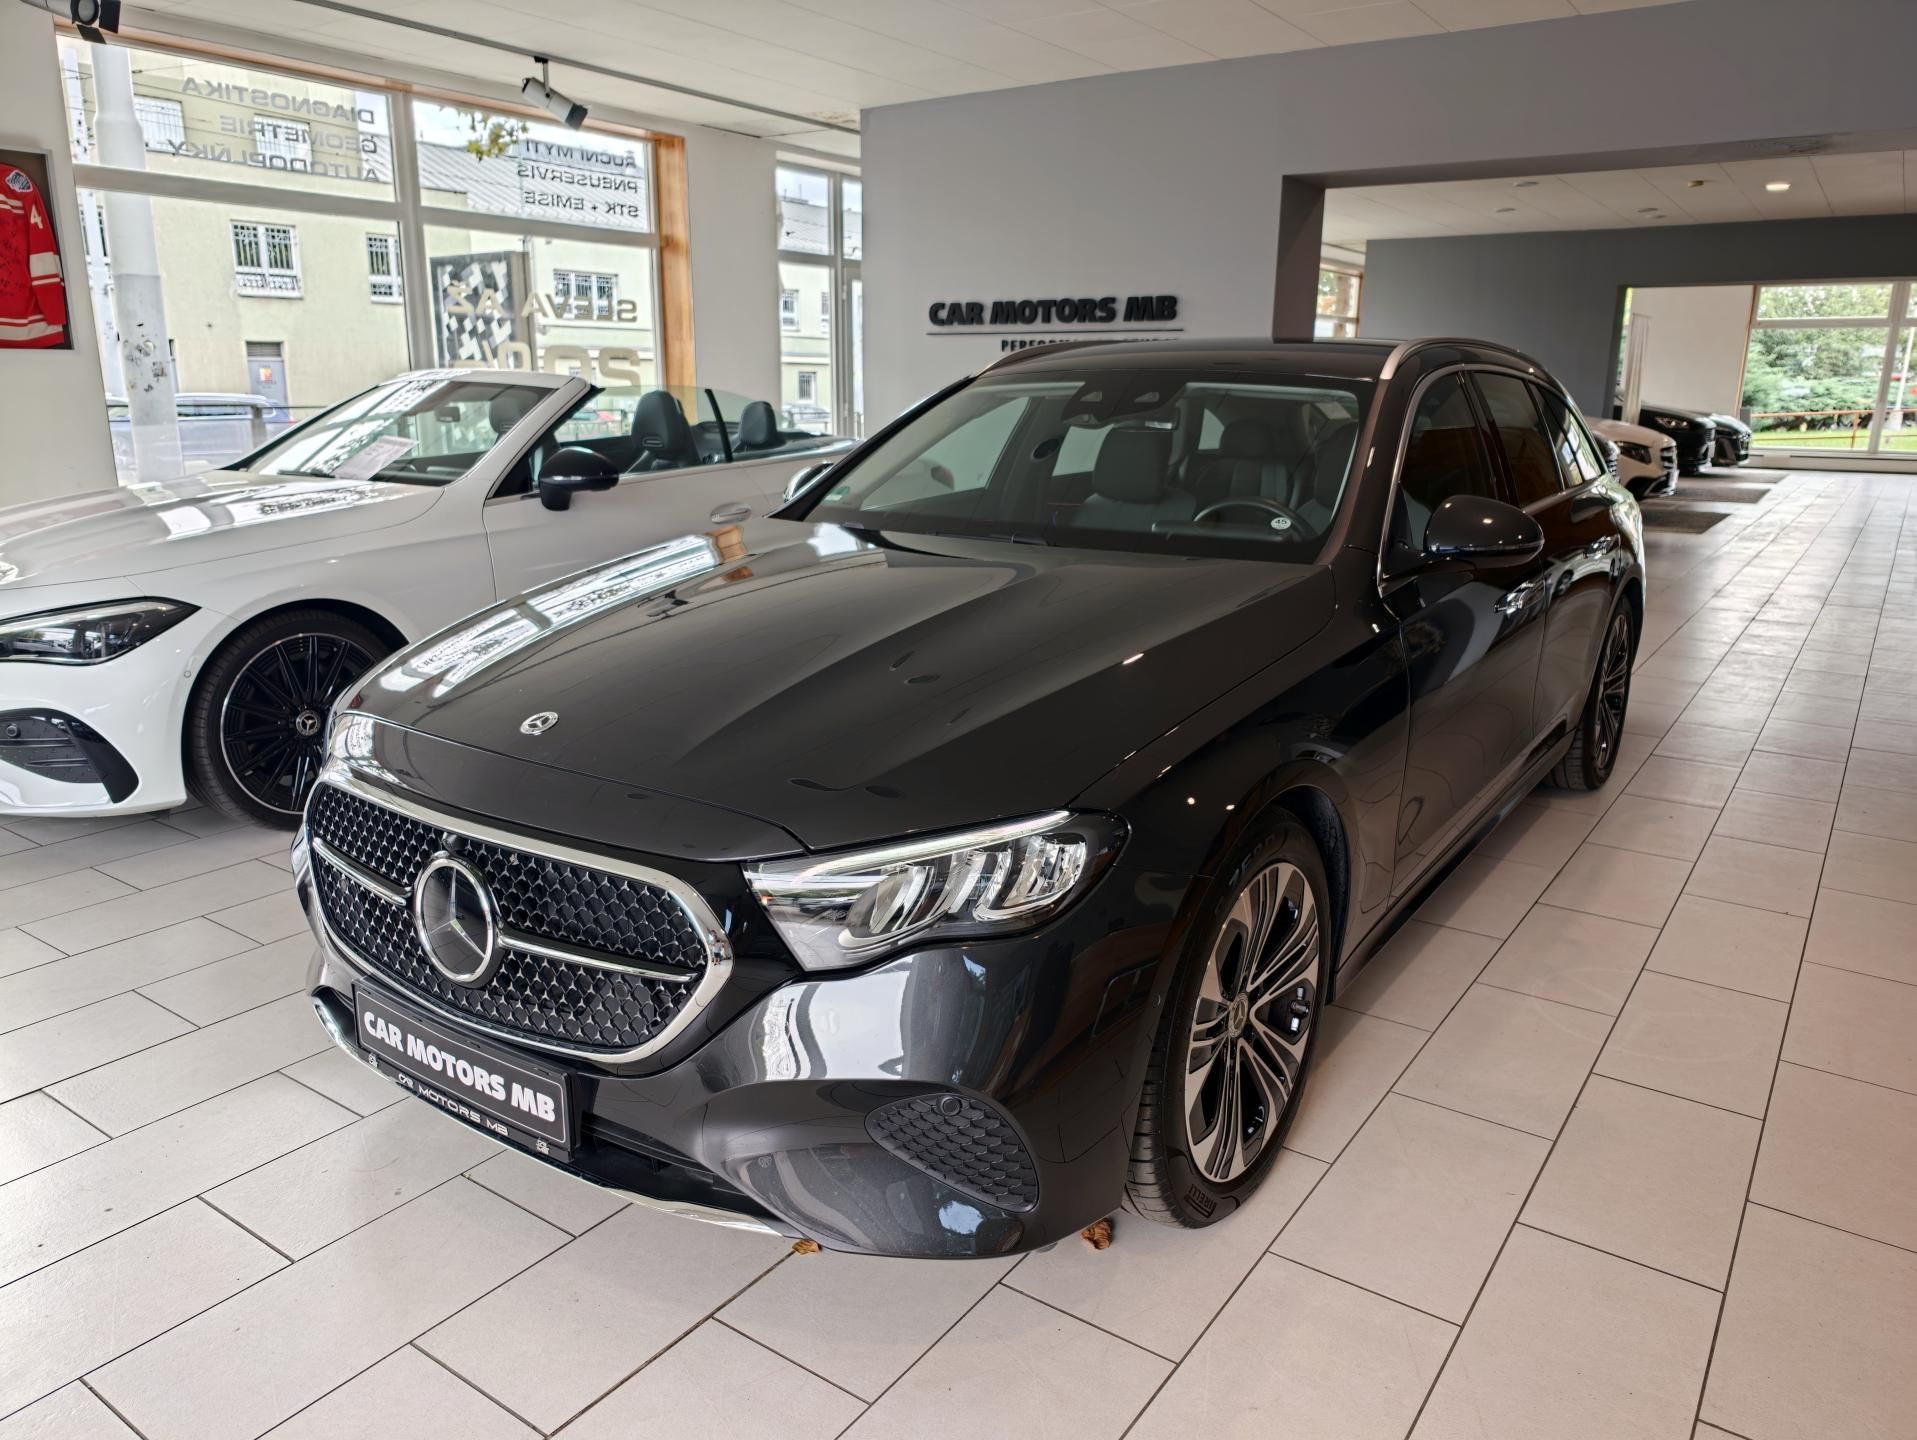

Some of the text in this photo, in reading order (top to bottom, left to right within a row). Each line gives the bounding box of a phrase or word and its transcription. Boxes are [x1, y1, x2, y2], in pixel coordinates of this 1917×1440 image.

[929, 295, 1179, 326] CAR MOTORS MB
[364, 1011, 556, 1123] CAR MOTORS MB
[398, 1073, 509, 1136] CAR MOTORS MB
